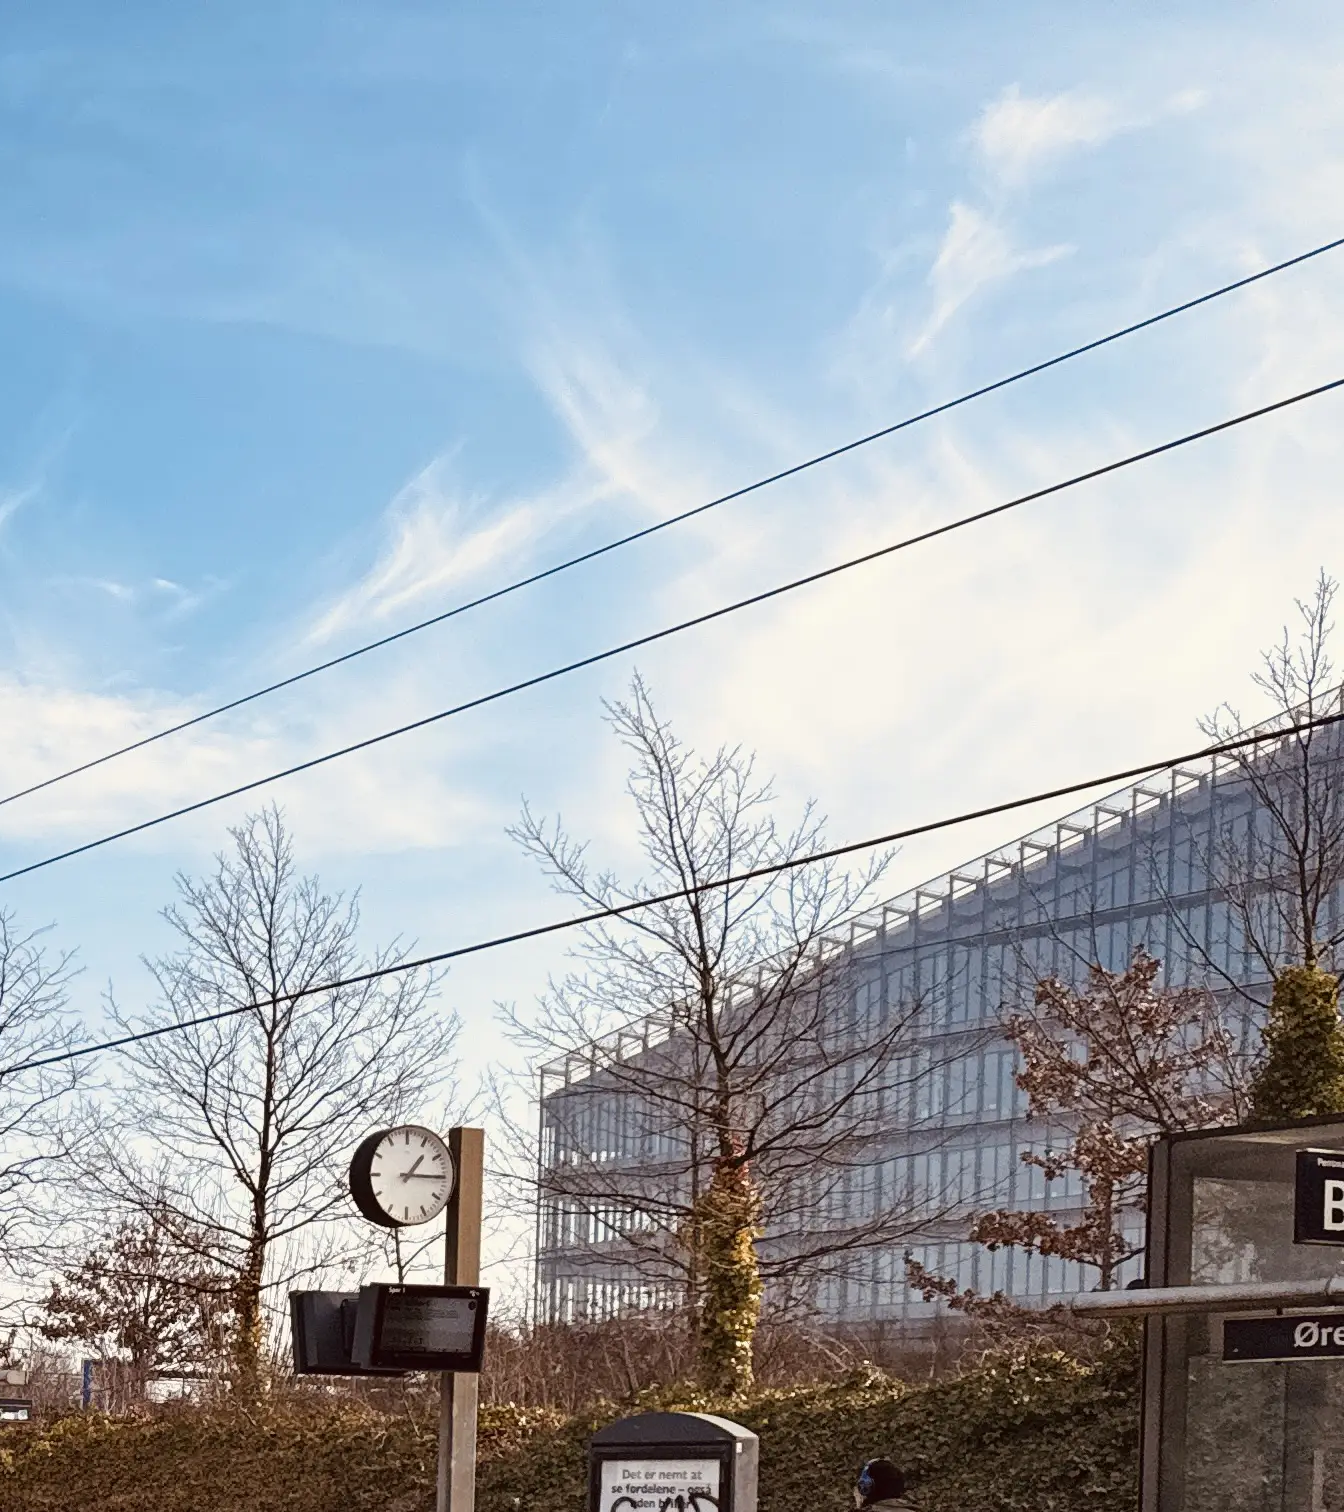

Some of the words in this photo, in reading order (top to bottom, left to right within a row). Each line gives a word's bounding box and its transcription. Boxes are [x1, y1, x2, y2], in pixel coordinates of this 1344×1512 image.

[1324, 1179, 1344, 1231] B
[1293, 1321, 1344, 1348] Øre
[622, 1469, 642, 1480] Det
[644, 1471, 656, 1480] er
[658, 1470, 688, 1480] nemt
[691, 1470, 703, 1480] at
[611, 1485, 623, 1494] se
[625, 1483, 676, 1494] fordelene
